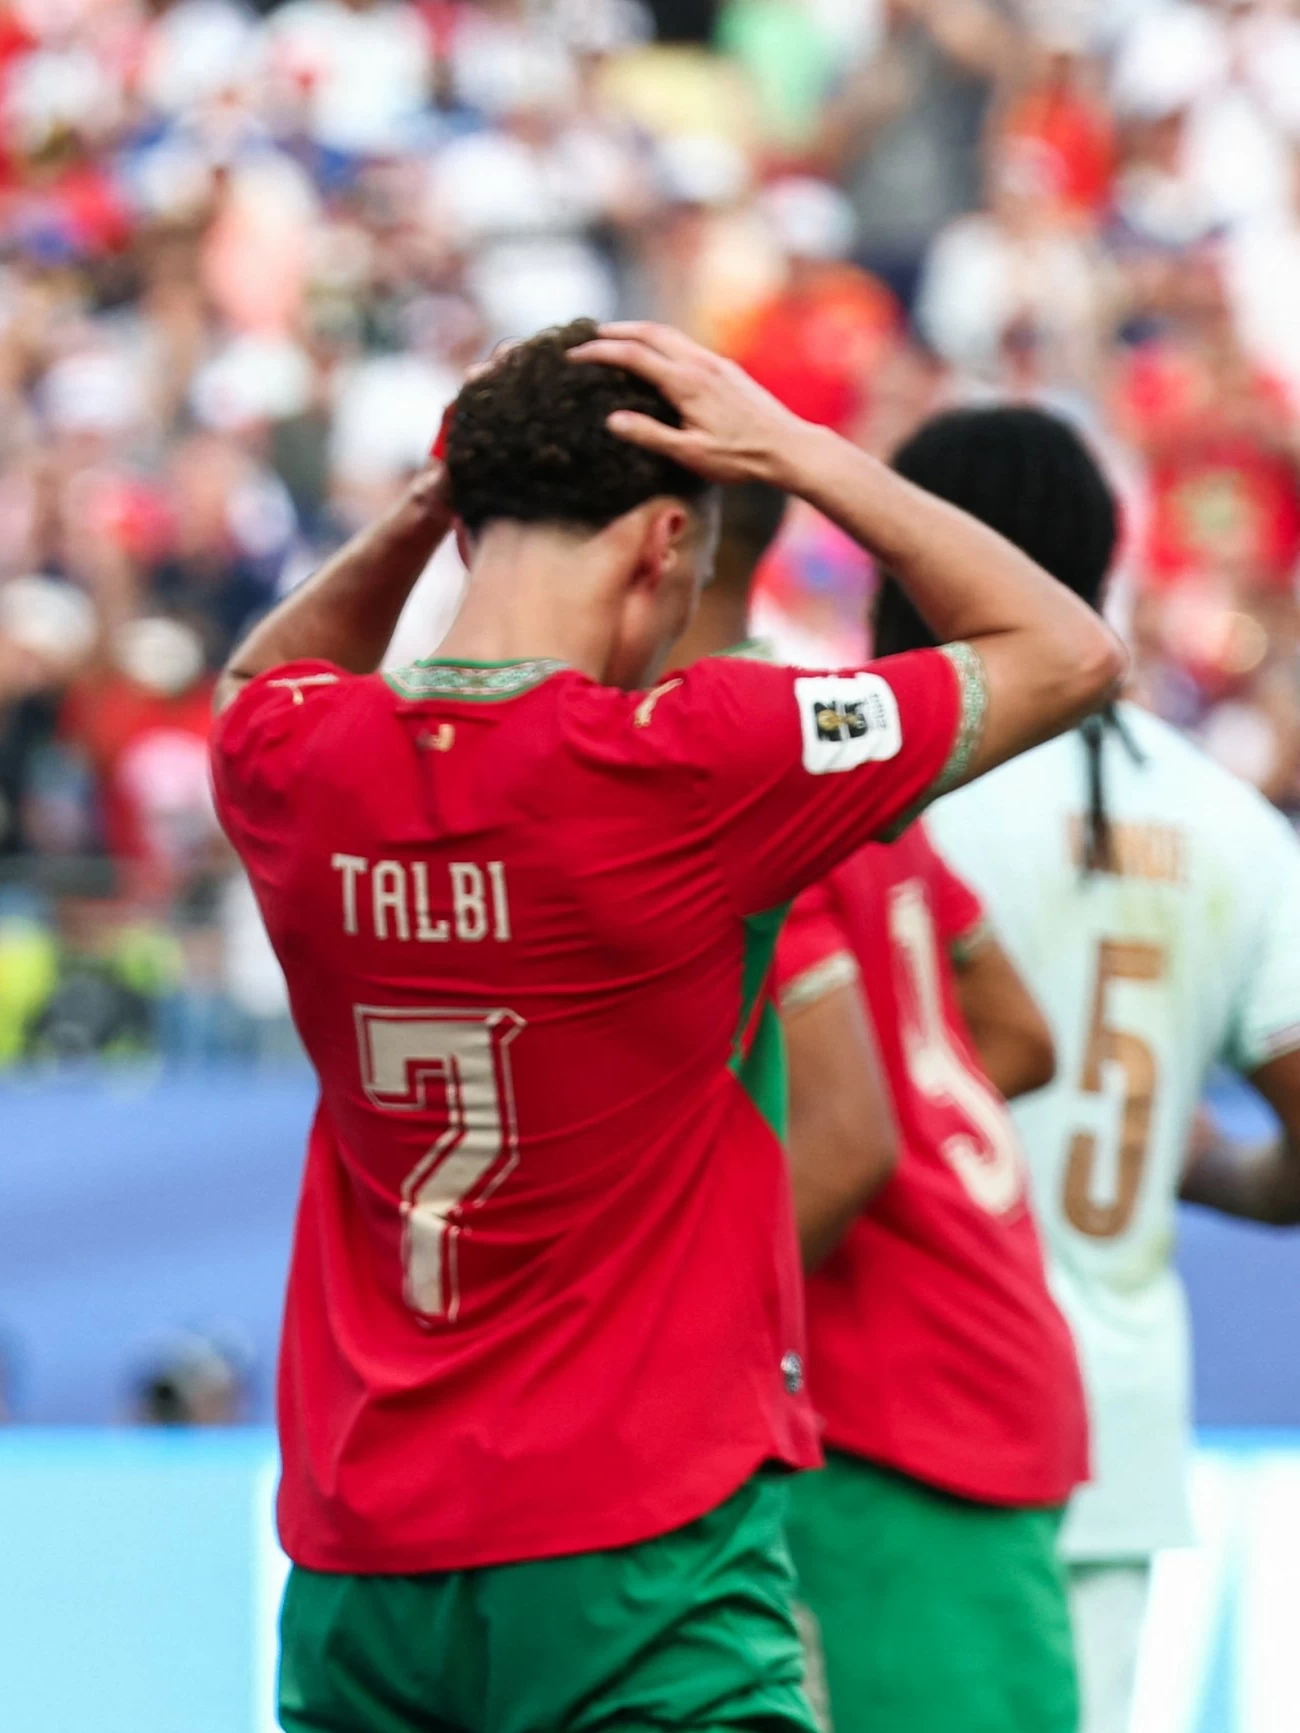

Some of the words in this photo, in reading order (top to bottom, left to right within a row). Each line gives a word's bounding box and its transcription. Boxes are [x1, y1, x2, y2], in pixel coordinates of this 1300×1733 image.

[332, 852, 511, 942] TALBI
[353, 1003, 527, 1326] 7
[1061, 937, 1168, 1242] 5
